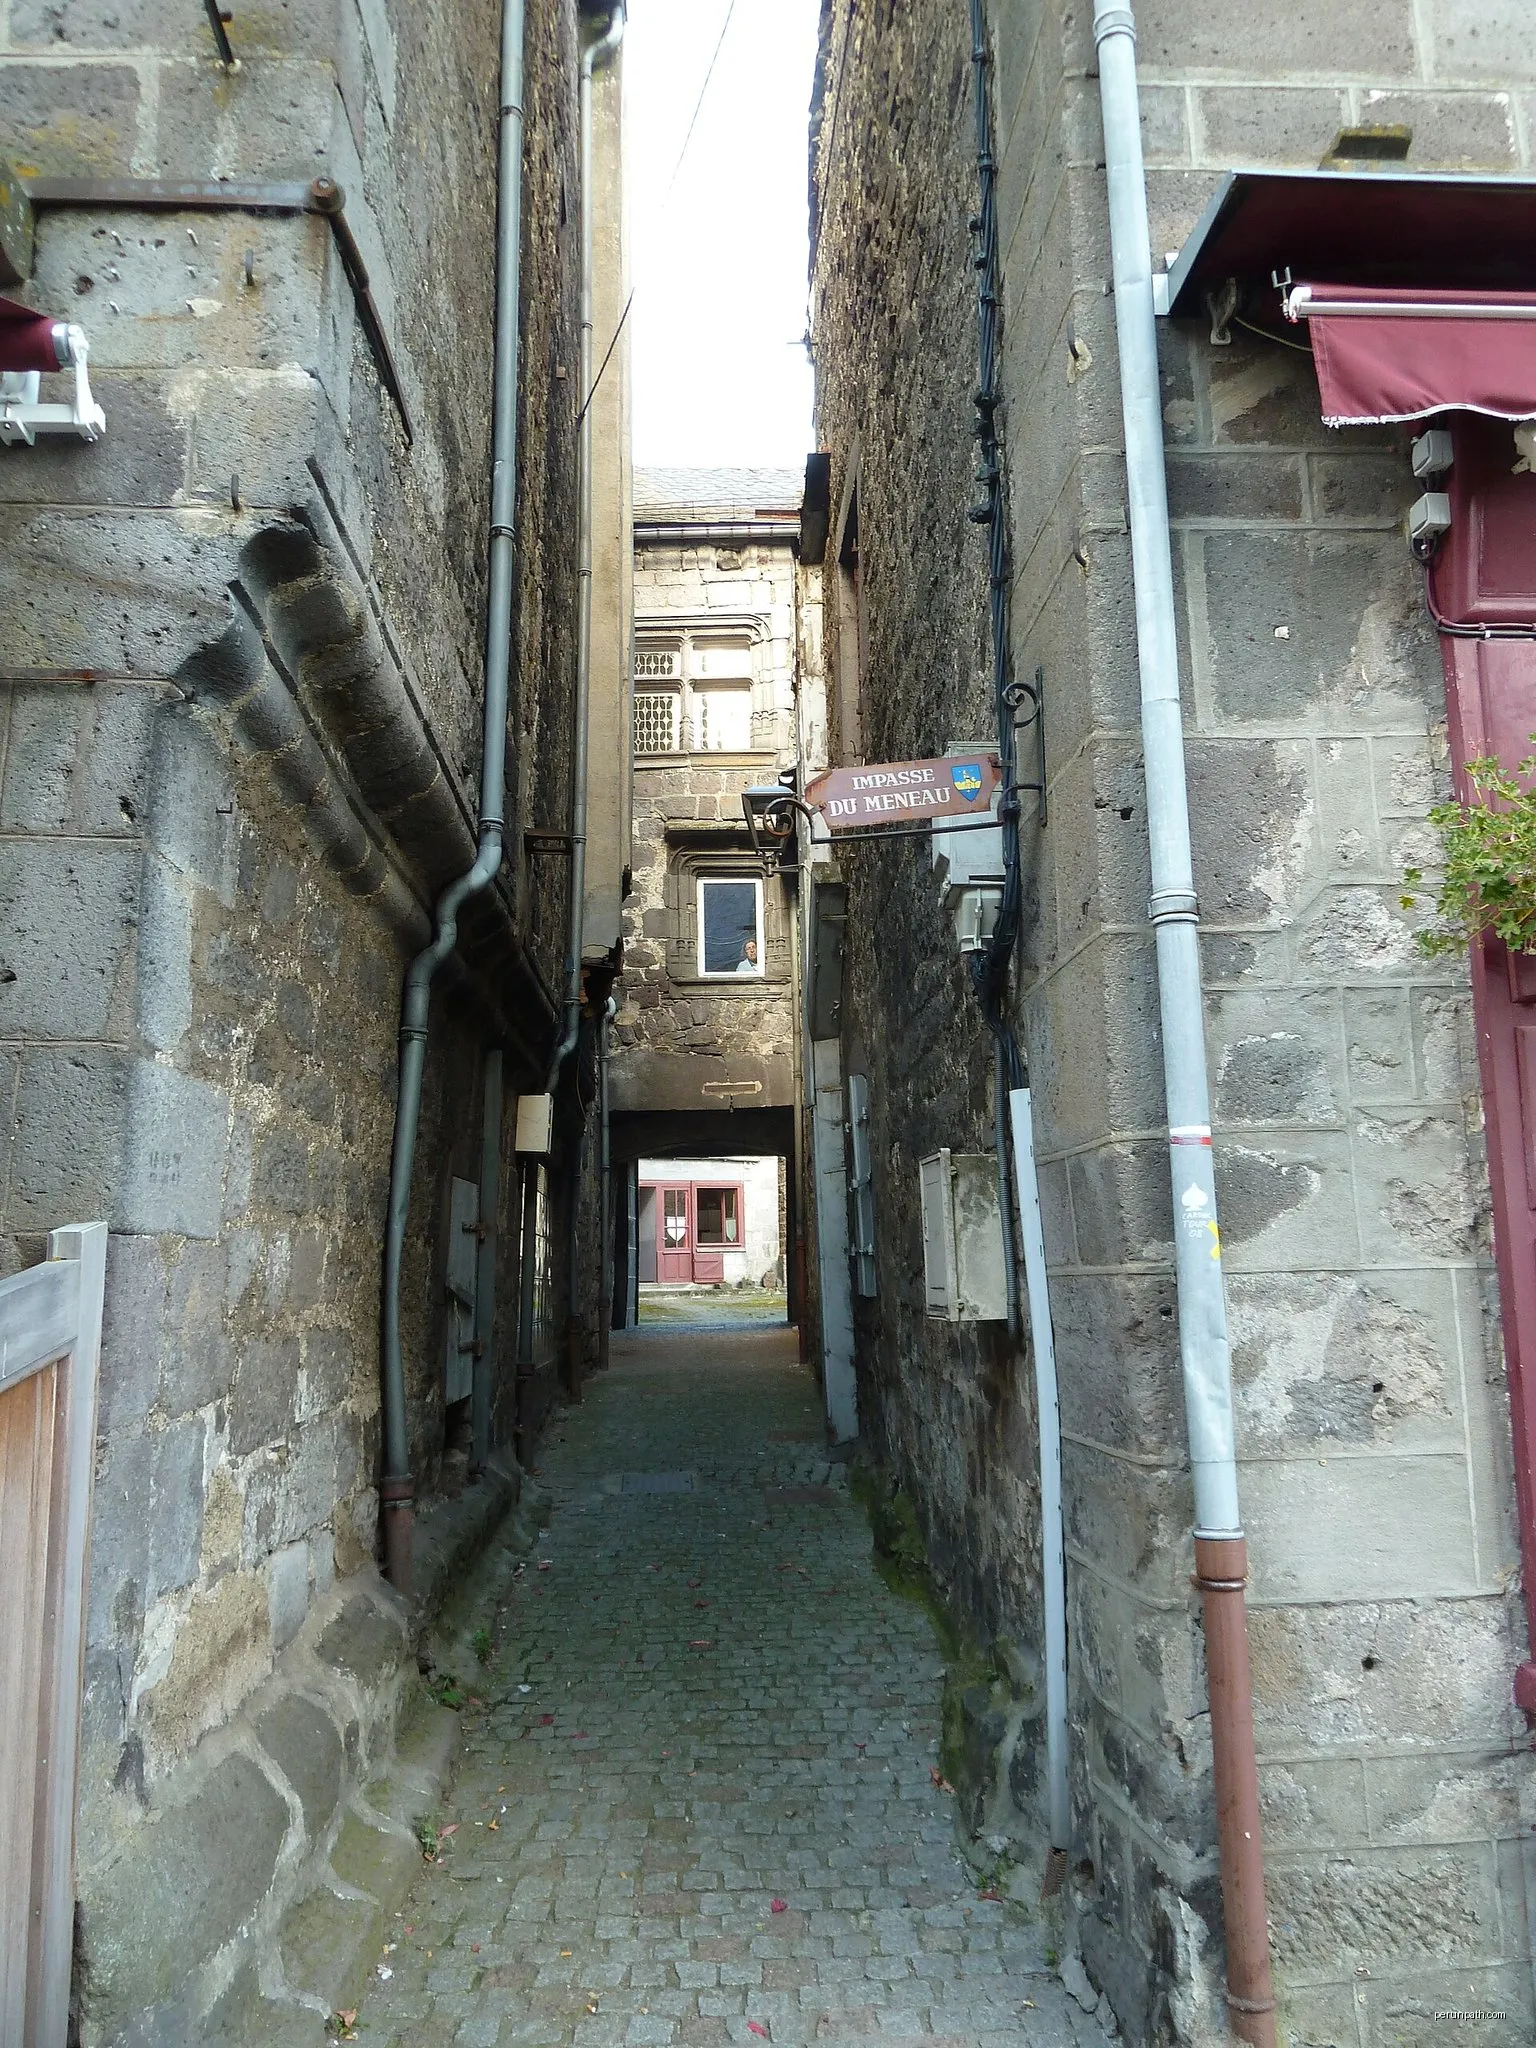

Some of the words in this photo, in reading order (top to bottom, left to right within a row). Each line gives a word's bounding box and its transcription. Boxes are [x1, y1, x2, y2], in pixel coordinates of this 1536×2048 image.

[852, 768, 935, 790] IMPASSE
[828, 798, 857, 817] DU
[864, 787, 950, 812] MENEAU
